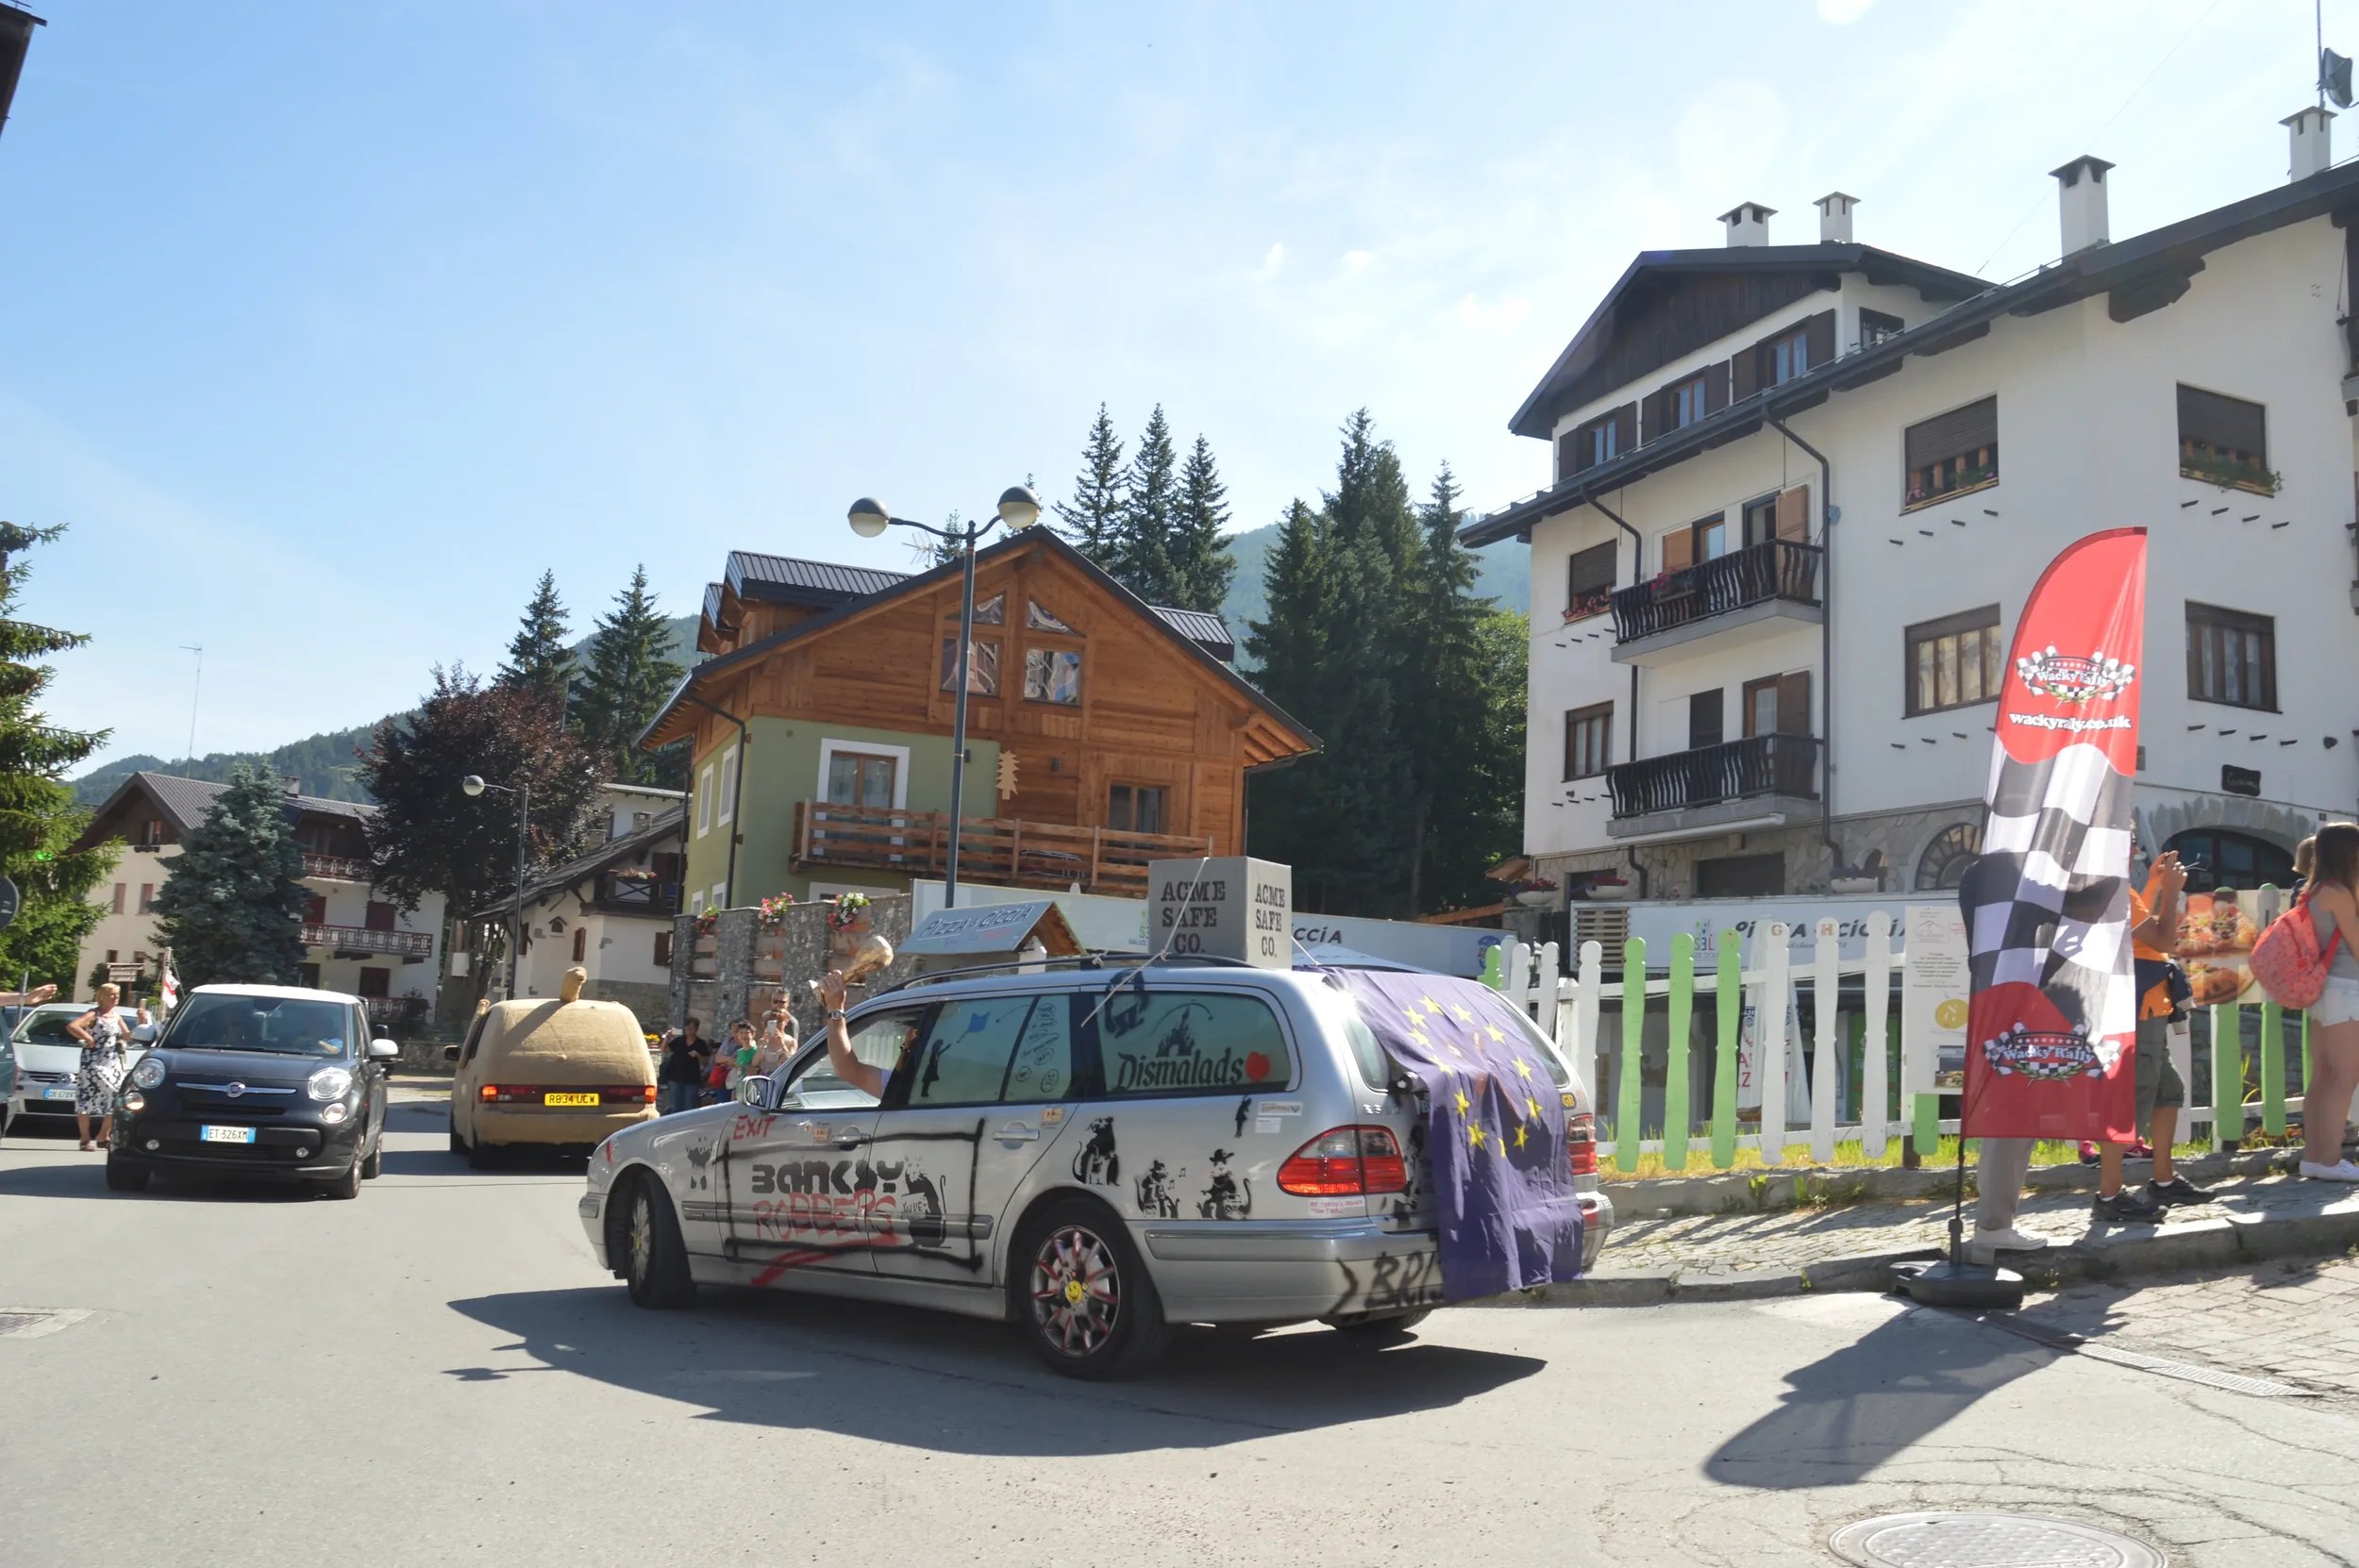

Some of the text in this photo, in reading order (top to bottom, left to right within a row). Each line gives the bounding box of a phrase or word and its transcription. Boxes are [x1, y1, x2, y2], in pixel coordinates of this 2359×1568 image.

[1160, 880, 1226, 902] ACME
[1254, 883, 1285, 909] ACME
[1162, 907, 1217, 928] SAFE
[1255, 909, 1282, 932] SAFE
[1173, 932, 1206, 955] CO.
[1261, 935, 1278, 958] CO.
[2002, 1044, 2095, 1063] Wacky Rally
[1114, 1046, 1245, 1091] Dismalads
[548, 1094, 595, 1104] R834 UCW
[209, 1128, 248, 1141] ET 326XM
[732, 1113, 778, 1141] EXIT
[752, 1188, 898, 1241] ROBBERS
